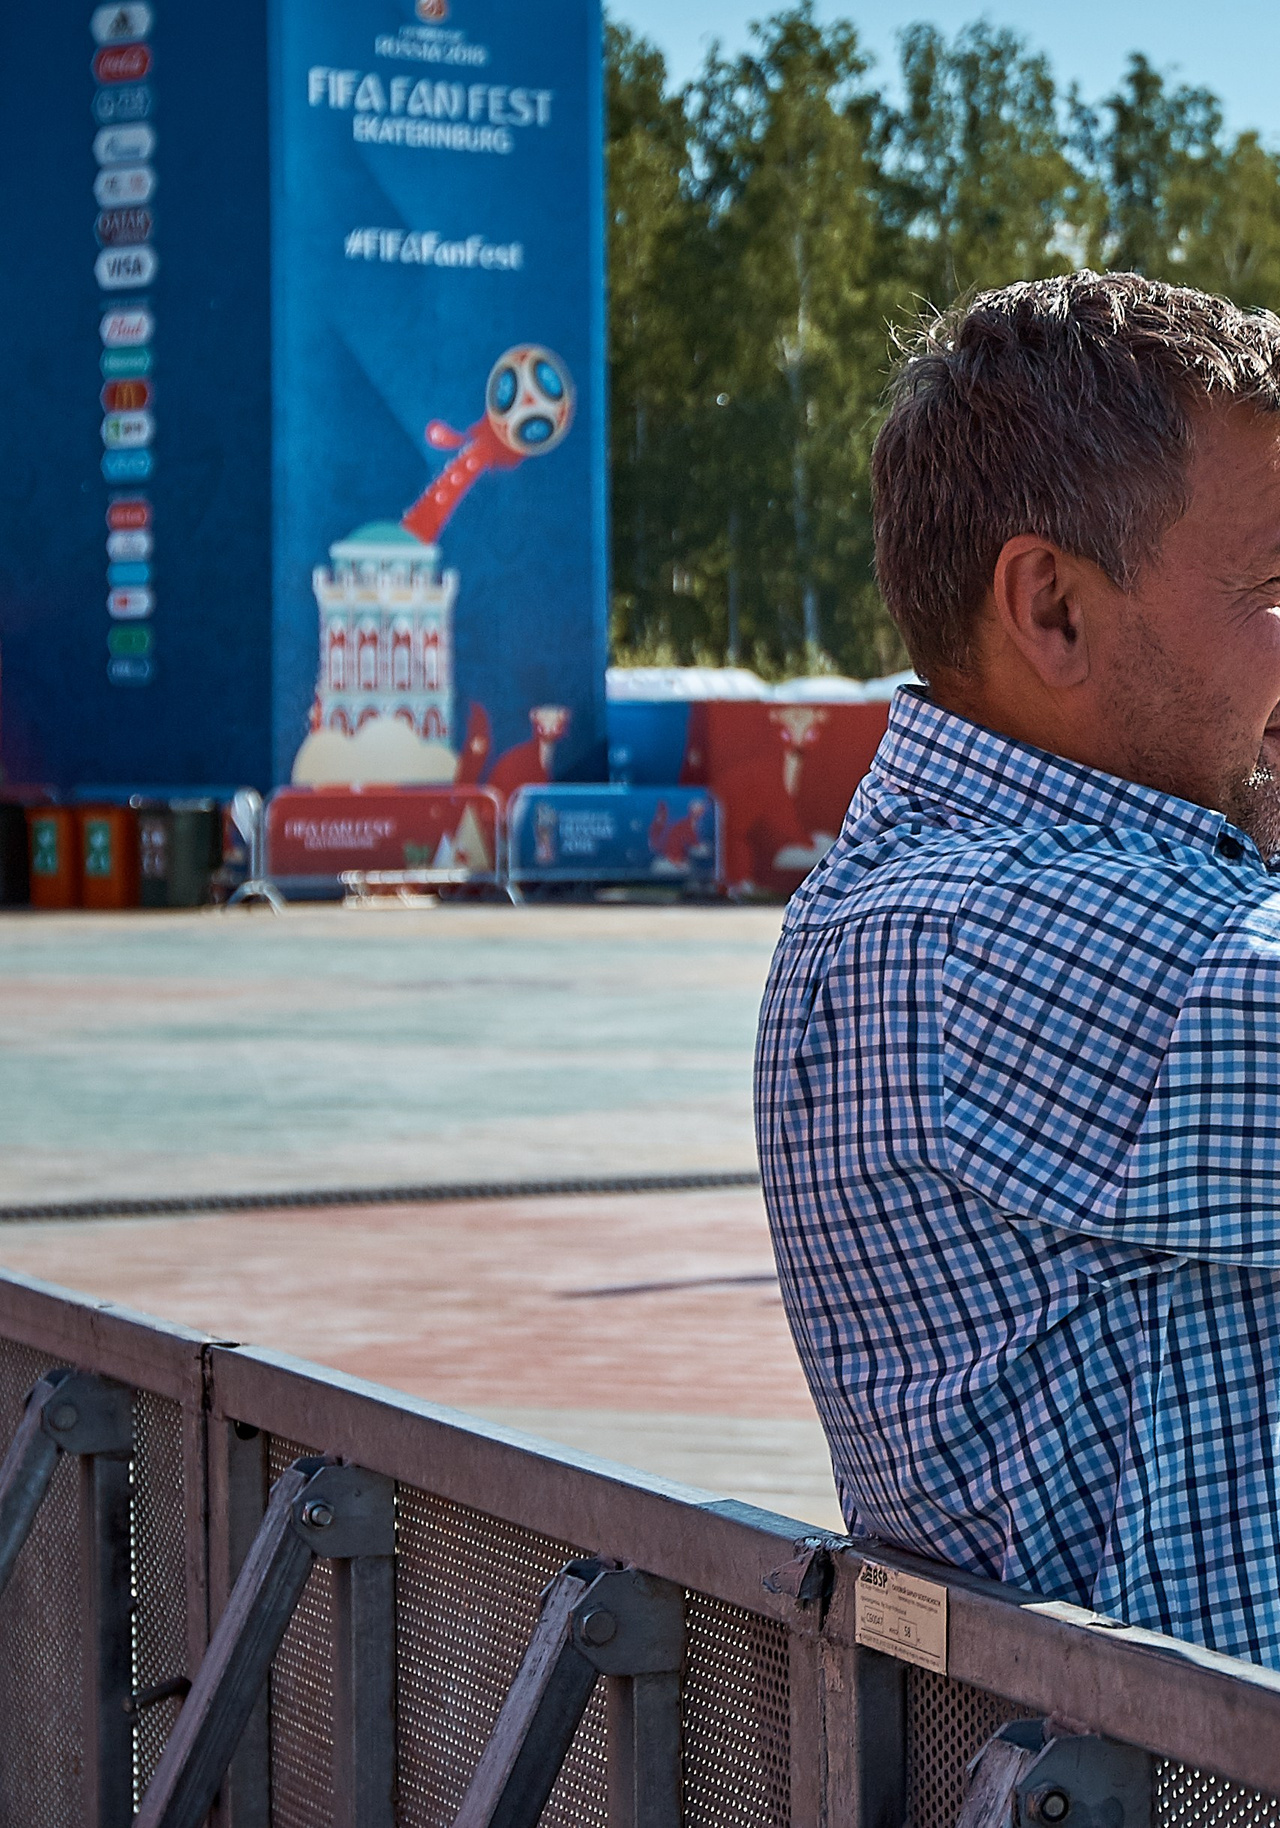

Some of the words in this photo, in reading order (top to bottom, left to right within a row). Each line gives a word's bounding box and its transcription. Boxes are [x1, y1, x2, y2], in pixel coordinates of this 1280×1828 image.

[308, 65, 387, 114] FIFA
[390, 75, 466, 120] FAN
[468, 83, 554, 128] FEST
[352, 113, 515, 155] EKATERINBURG
[106, 256, 143, 280] VISA
[344, 226, 524, 271] #FIFAFanFest
[873, 1567, 888, 1589] BSP
